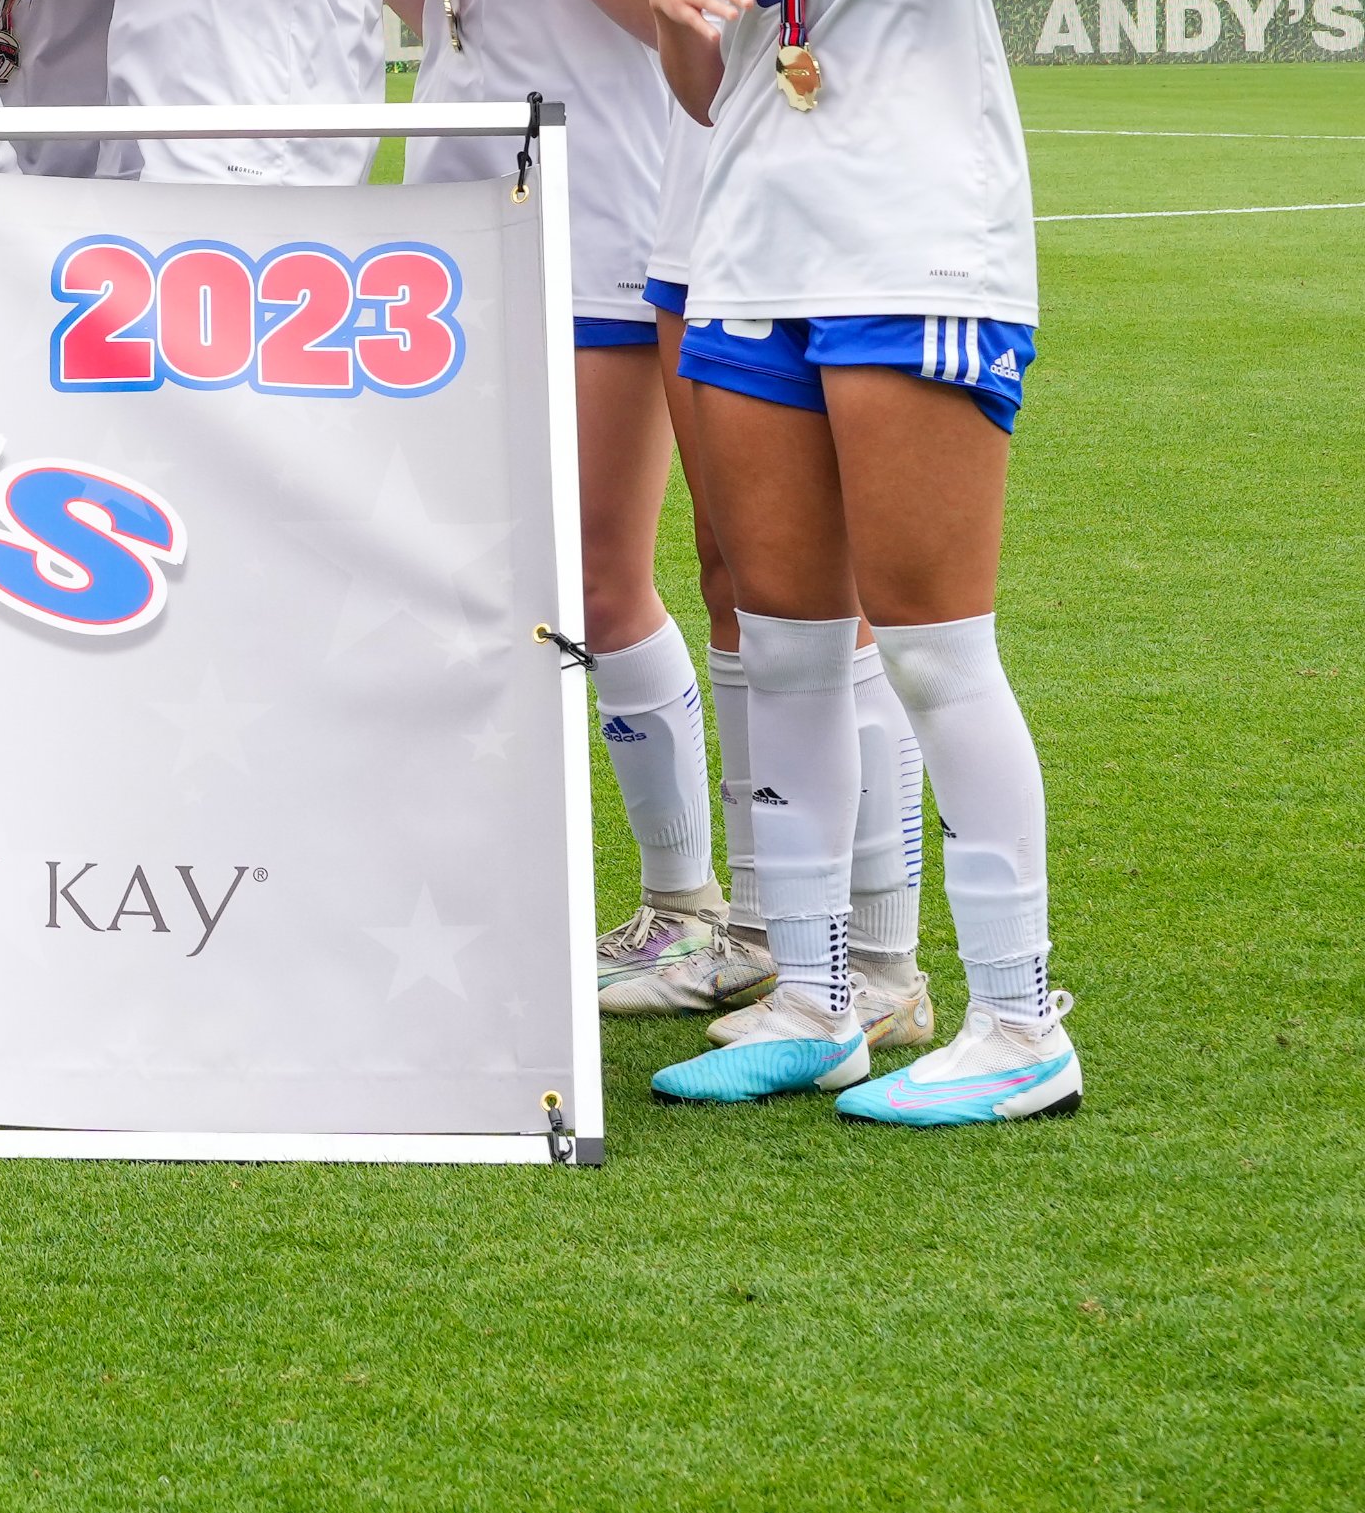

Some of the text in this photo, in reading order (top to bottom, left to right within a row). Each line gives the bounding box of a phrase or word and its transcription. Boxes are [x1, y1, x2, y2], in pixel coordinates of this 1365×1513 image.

[50, 234, 464, 397] 2023
[990, 364, 1020, 381] adidas
[45, 860, 249, 957] KAY
